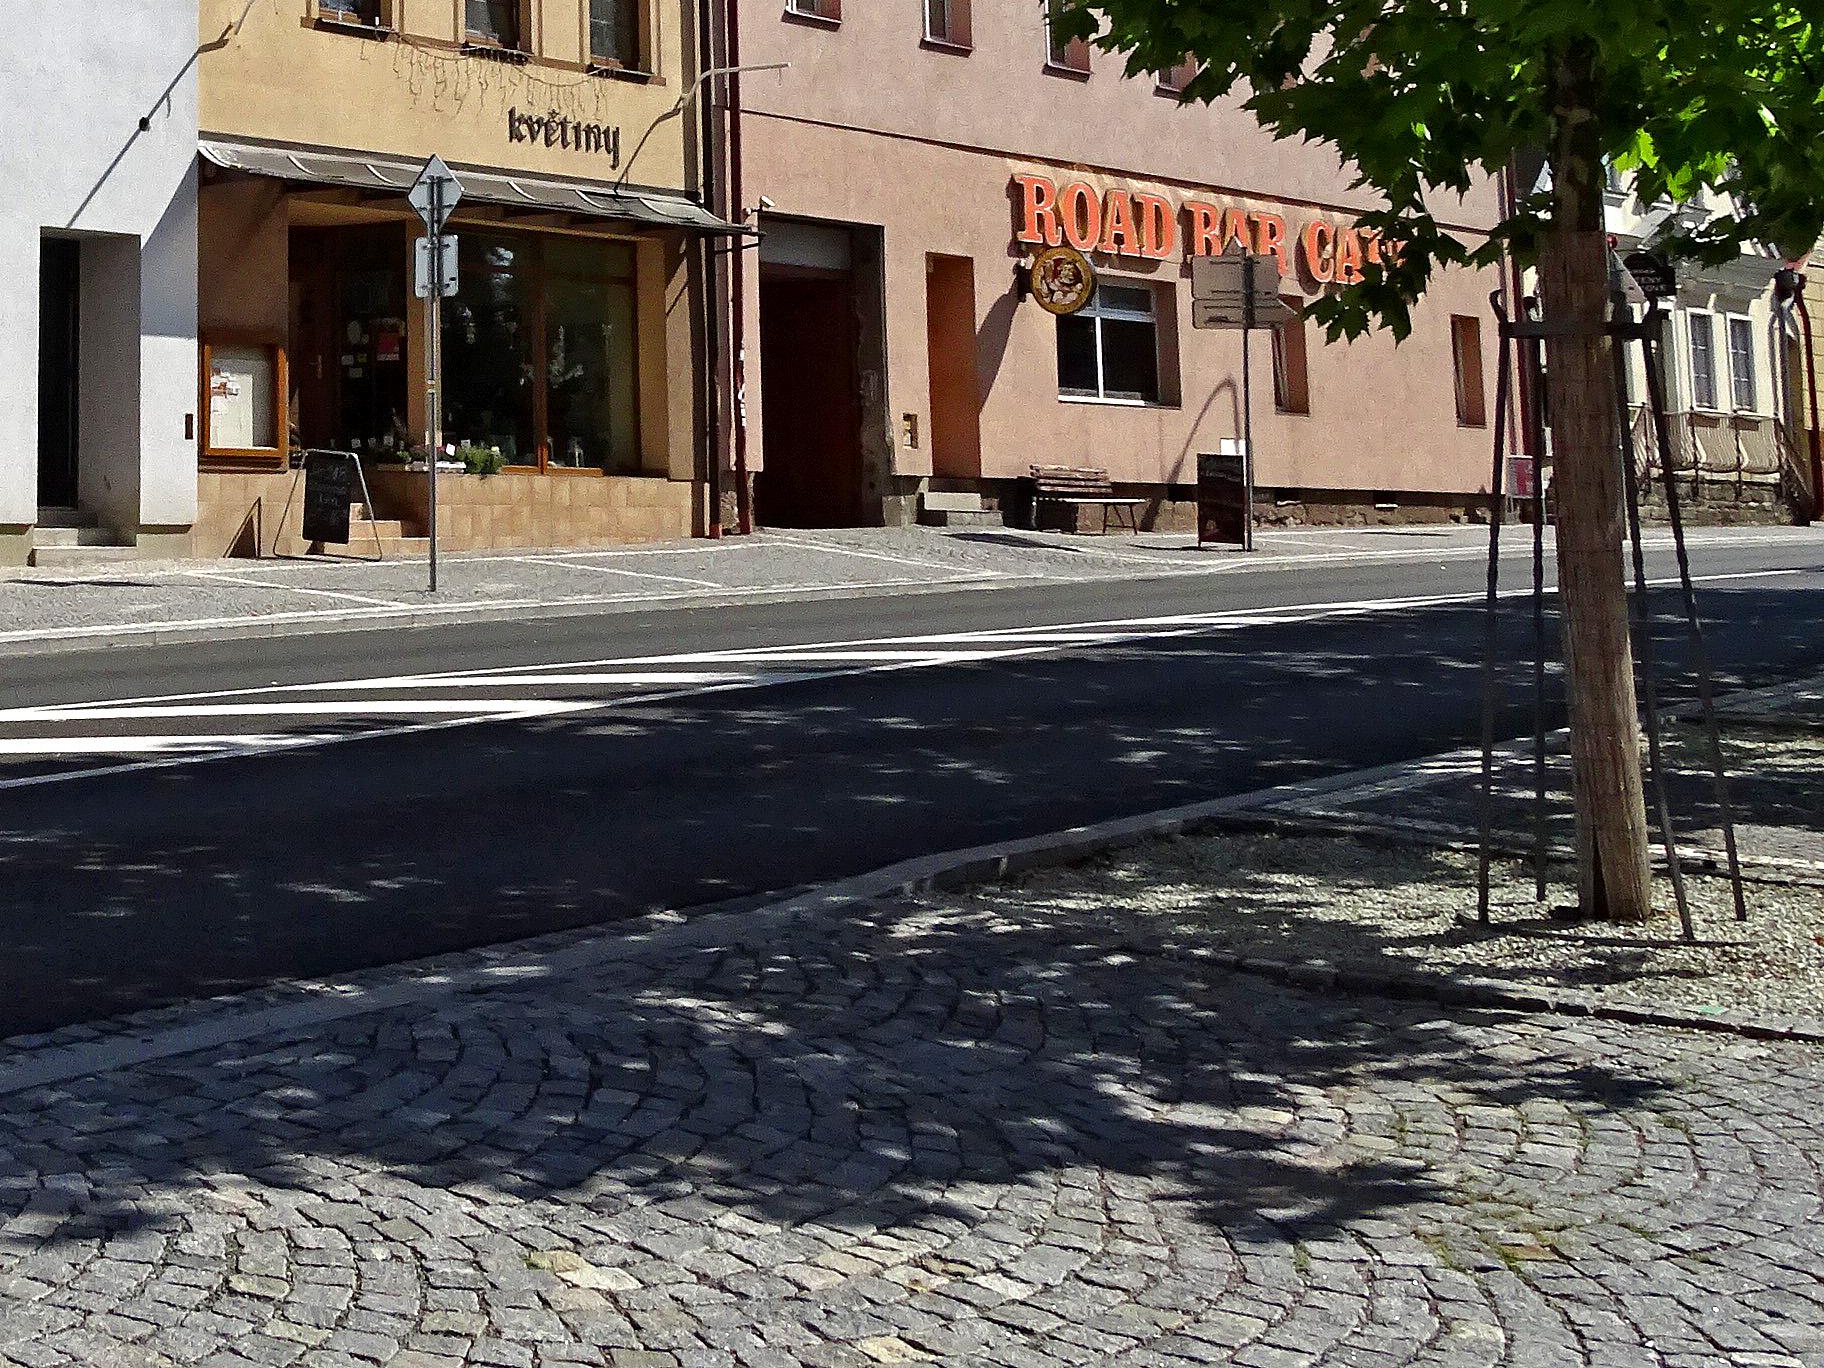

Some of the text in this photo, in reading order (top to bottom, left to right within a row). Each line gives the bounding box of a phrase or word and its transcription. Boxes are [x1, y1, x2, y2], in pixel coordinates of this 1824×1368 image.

[508, 106, 620, 170] květiny
[1016, 175, 1174, 258] ROAD
[1185, 202, 1287, 275] BAR
